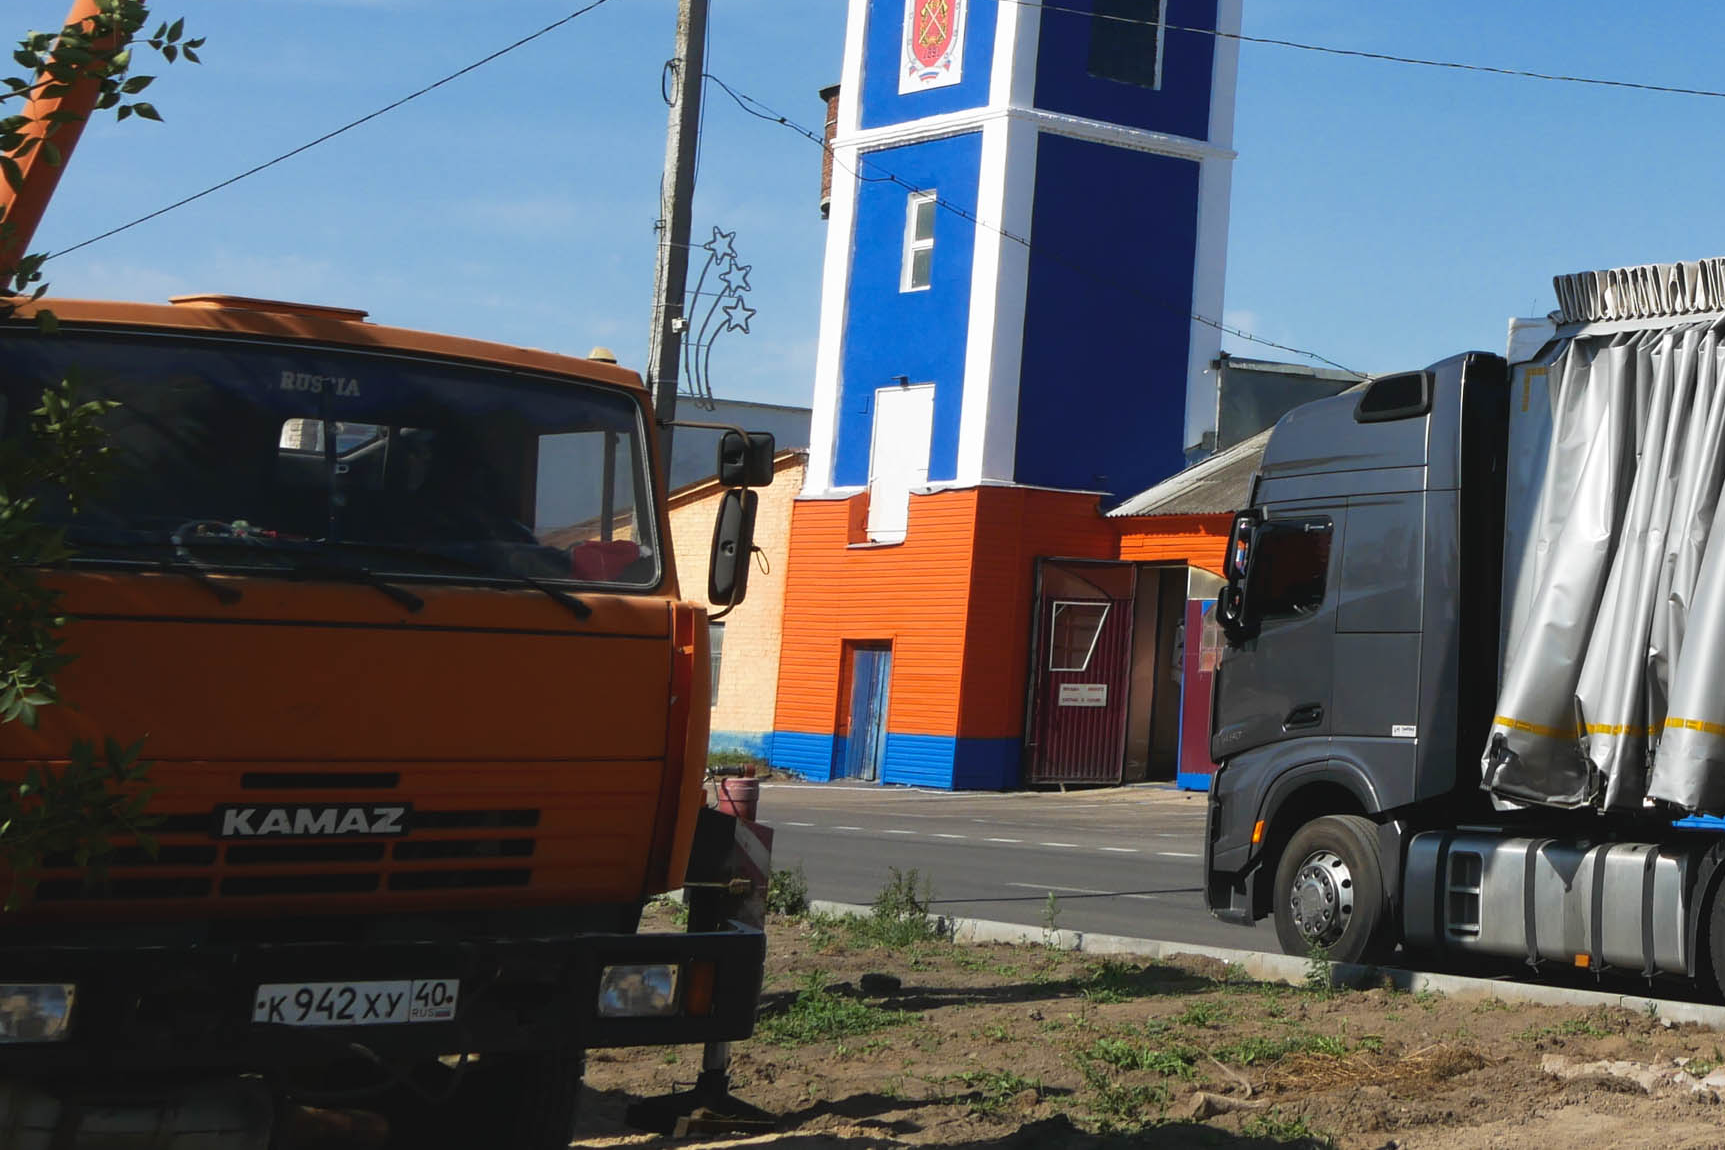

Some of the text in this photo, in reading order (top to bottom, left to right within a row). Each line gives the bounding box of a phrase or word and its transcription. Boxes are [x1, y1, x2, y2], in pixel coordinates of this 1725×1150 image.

[222, 807, 404, 836] KAMAZ
[415, 982, 447, 1007] 40
[412, 1009, 434, 1018] RUS
